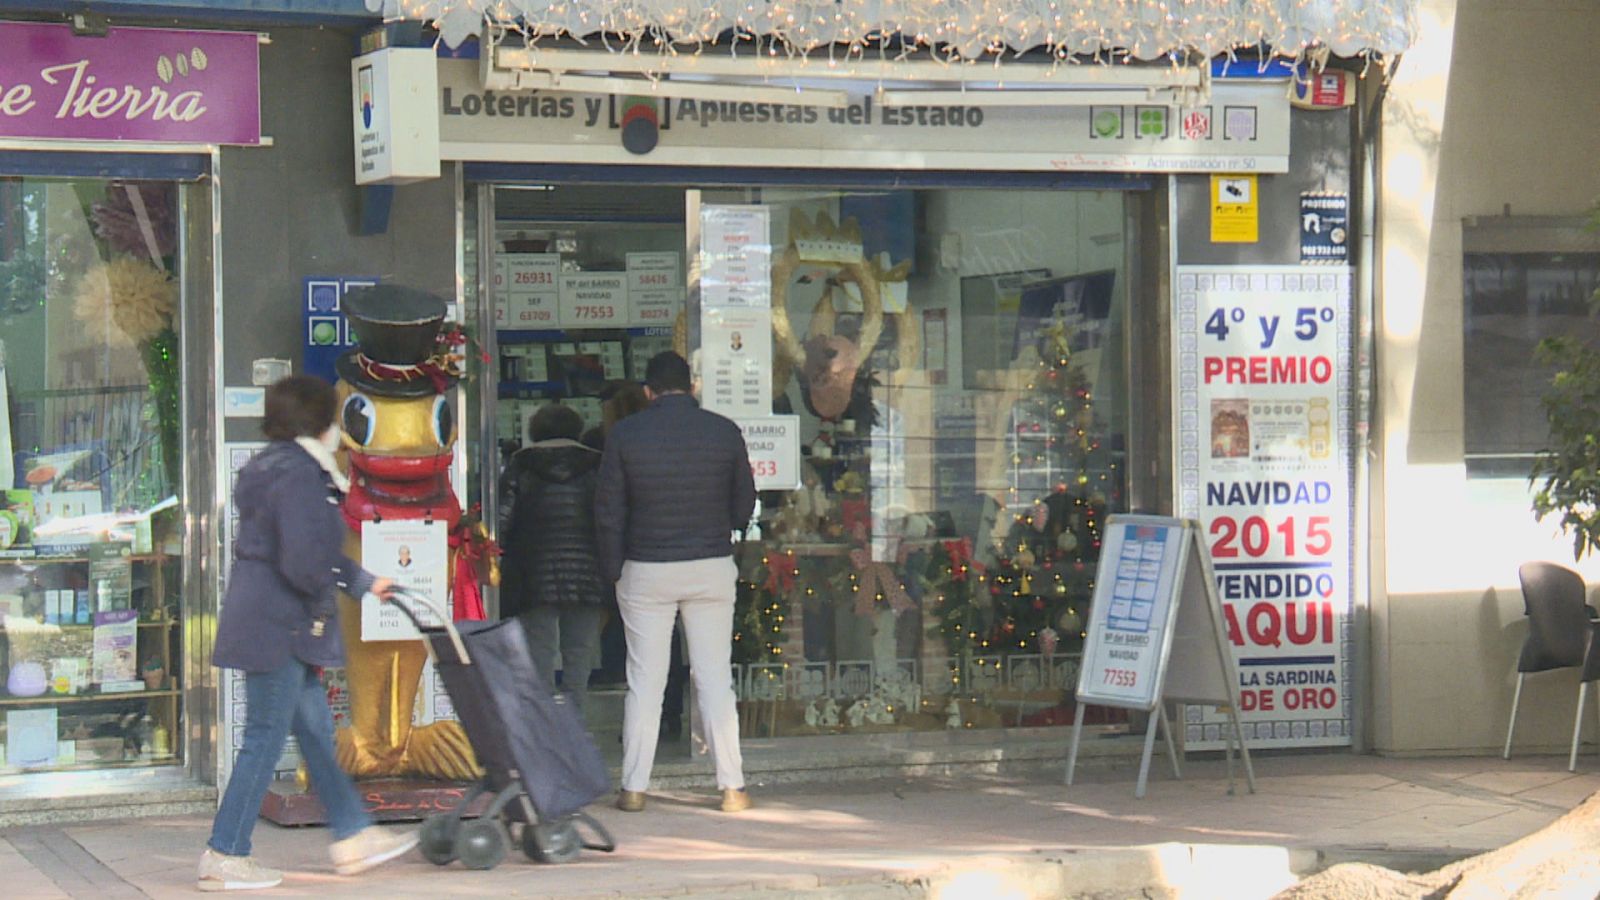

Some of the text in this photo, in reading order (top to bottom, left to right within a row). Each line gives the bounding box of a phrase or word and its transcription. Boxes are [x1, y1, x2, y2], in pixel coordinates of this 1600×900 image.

[0, 60, 207, 122] e Tierra
[442, 87, 575, 118] Loterías
[584, 97, 601, 127] y
[675, 97, 818, 128] Apuestas
[881, 102, 984, 128] Estado
[1147, 157, 1226, 169] Administración
[1243, 158, 1257, 169] 50
[514, 271, 553, 284] 26931
[591, 279, 621, 289] BARRIO
[575, 292, 612, 300] NAVIDAD
[574, 305, 615, 319] 77553
[1204, 306, 1335, 349] 4º y 5º
[1203, 355, 1333, 385] PREMIO
[748, 425, 787, 435] BARRIO
[1206, 481, 1331, 506] NAVIDAD
[1209, 515, 1333, 558] 2015
[1109, 649, 1140, 661] NAVIDAD
[1103, 668, 1137, 688] 77553
[1239, 670, 1337, 687] LA SARDINA
[1240, 687, 1337, 712] DE ORO
